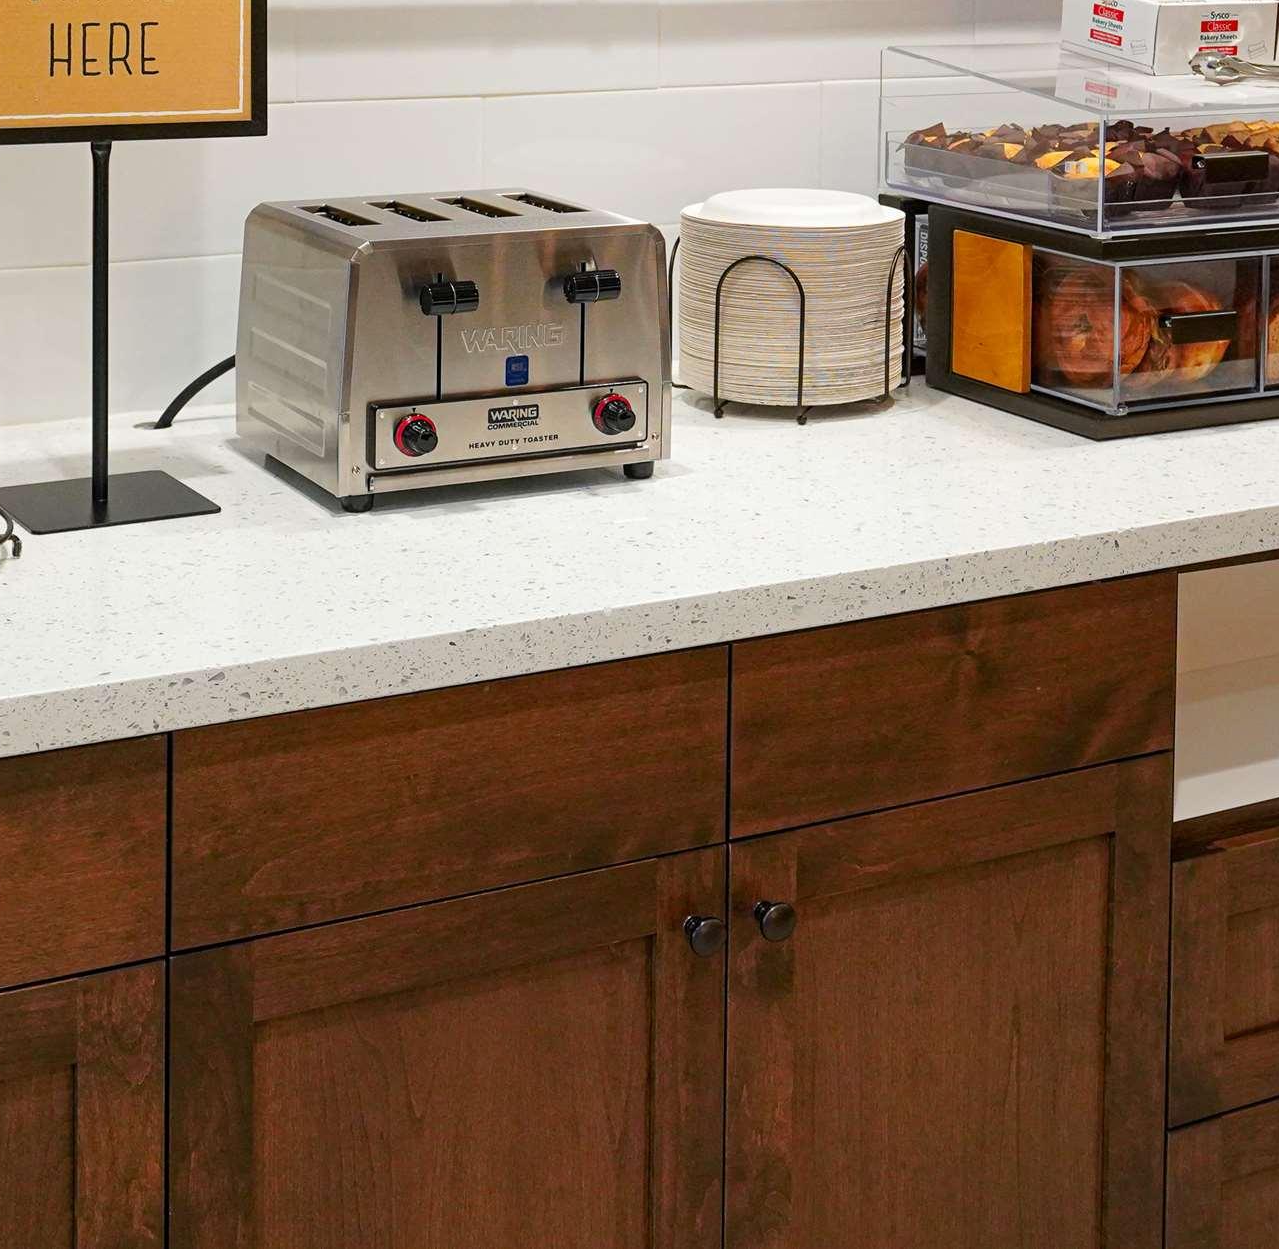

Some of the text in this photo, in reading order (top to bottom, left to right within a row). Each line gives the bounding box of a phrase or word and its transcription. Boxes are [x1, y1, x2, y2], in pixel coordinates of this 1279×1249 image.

[1210, 11, 1230, 20] Sysco
[1207, 21, 1233, 32] Classic
[49, 21, 160, 77] HERE
[460, 322, 564, 355] WARING
[490, 407, 538, 422] WARING
[487, 420, 539, 430] COMMERCIAL
[468, 434, 559, 449] HEAVY DUTY TOASTER
